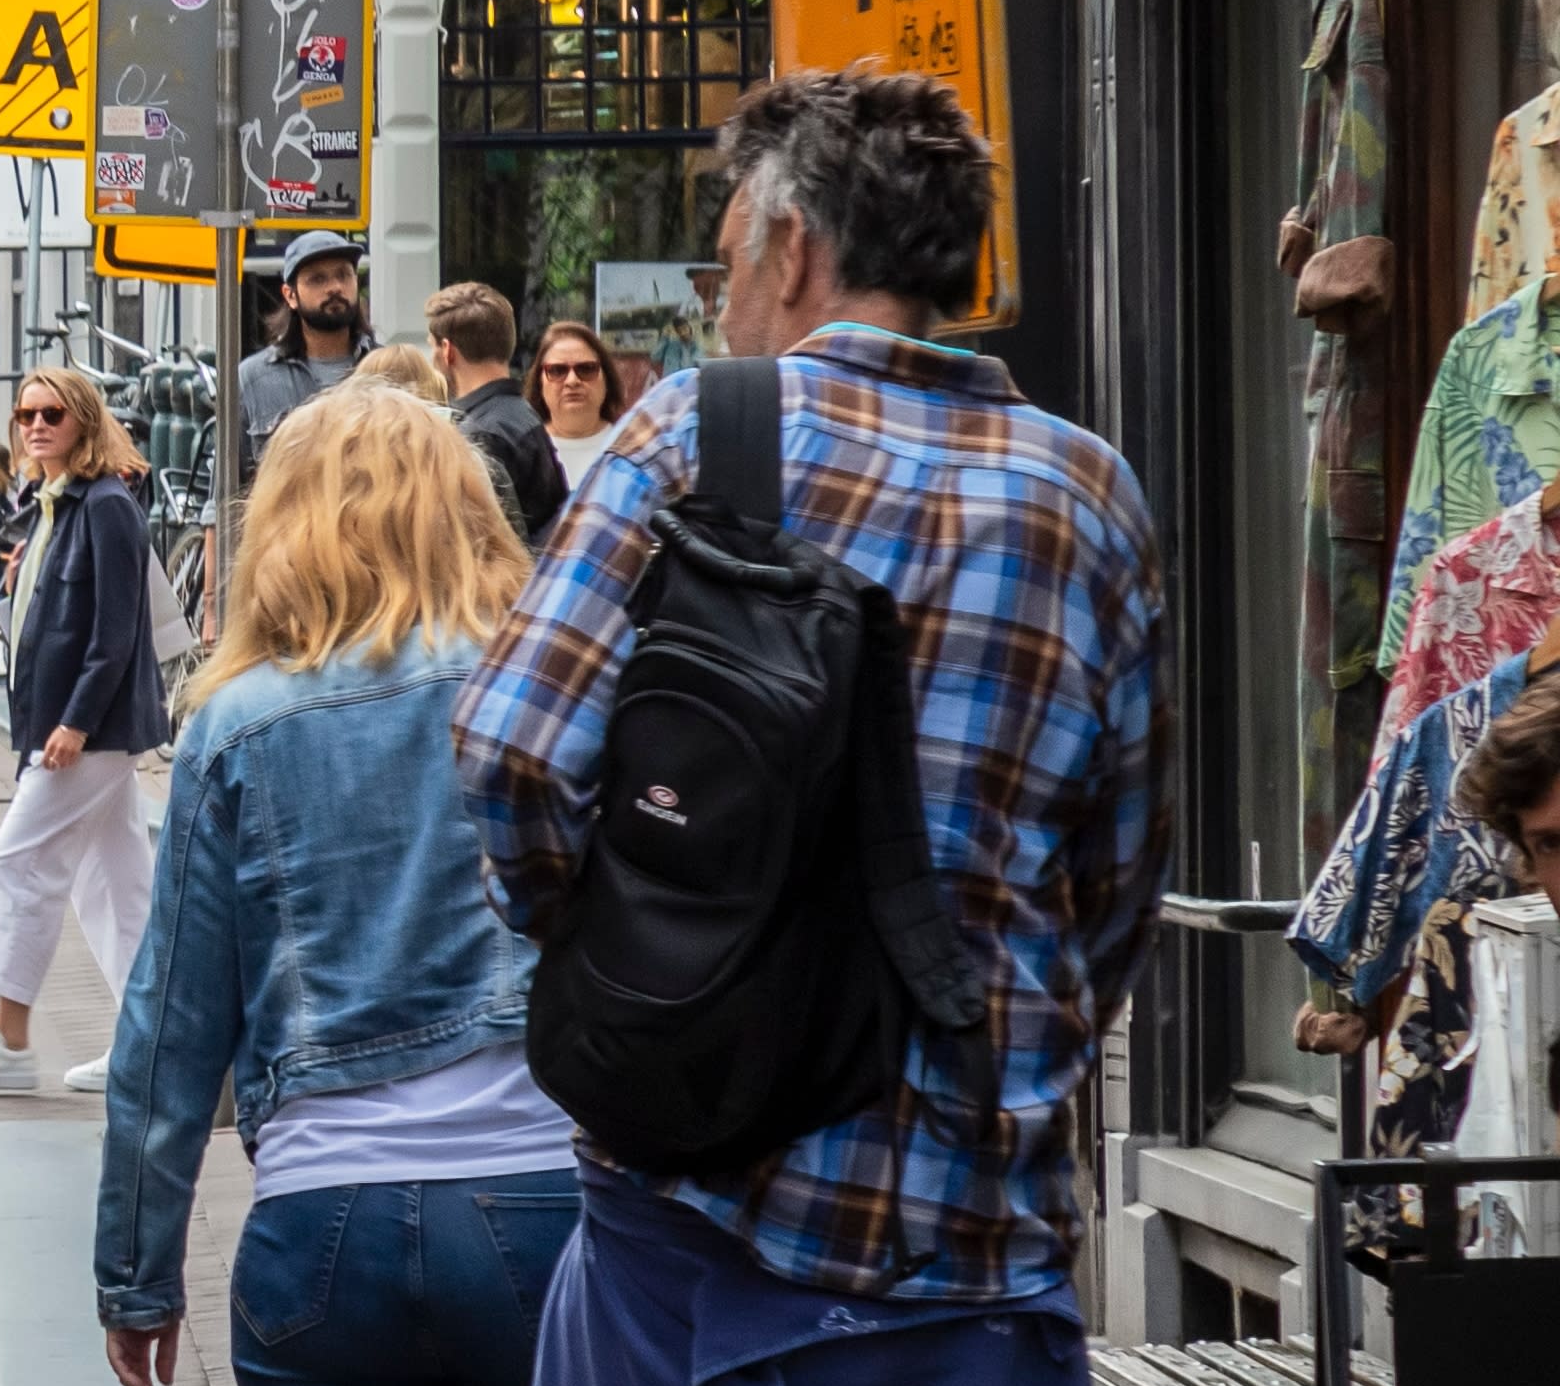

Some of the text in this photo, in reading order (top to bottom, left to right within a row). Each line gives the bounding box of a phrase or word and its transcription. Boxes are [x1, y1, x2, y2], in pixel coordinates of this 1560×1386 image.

[0, 10, 78, 90] A
[303, 70, 337, 82] GENOA
[311, 130, 358, 152] STRANGE
